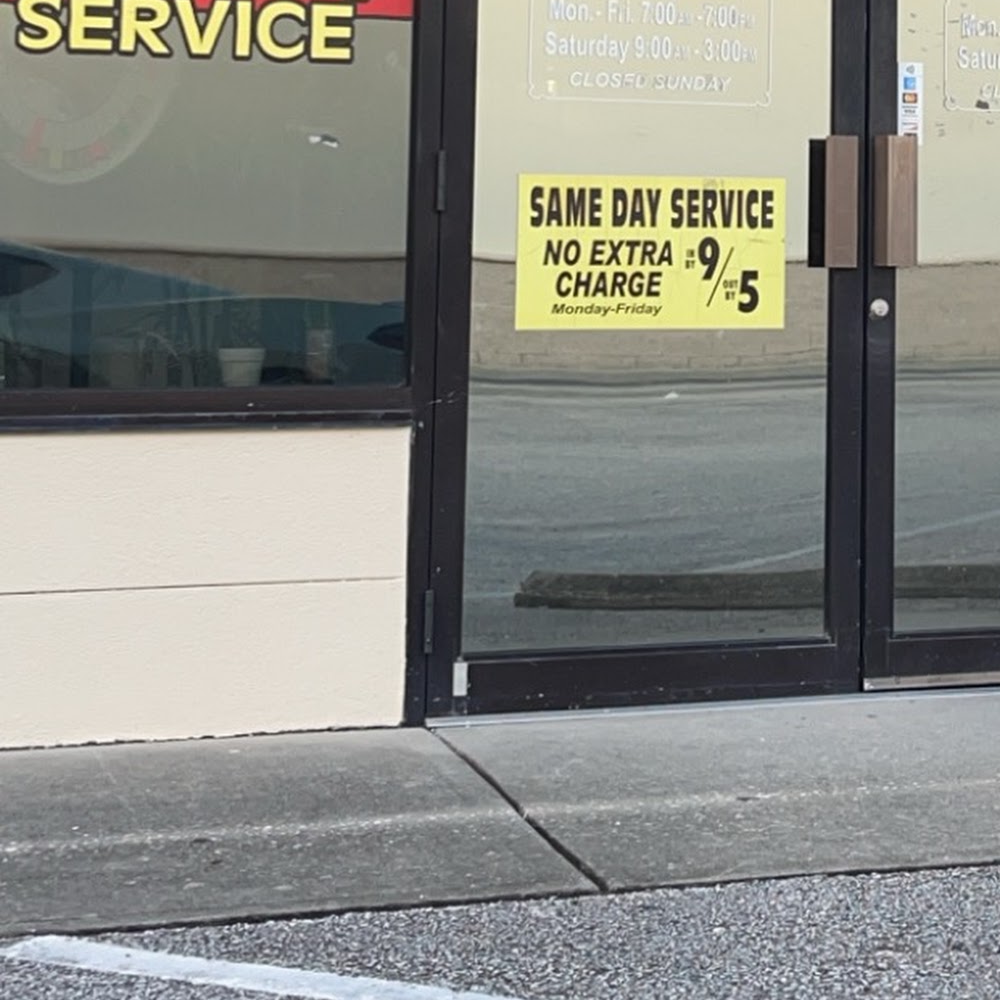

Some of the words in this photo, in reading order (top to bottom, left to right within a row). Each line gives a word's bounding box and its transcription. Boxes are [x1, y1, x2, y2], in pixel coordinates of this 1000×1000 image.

[544, 30, 629, 63] Saturday
[569, 71, 647, 89] CLOSED
[653, 74, 732, 92] SUNDAY
[530, 186, 602, 227] SAME
[612, 188, 661, 228] DAY
[671, 188, 774, 229] SERVICE
[543, 240, 581, 266] NO
[589, 240, 673, 266] EXTRA
[698, 236, 720, 281] 9
[555, 271, 662, 298] CHARGE
[738, 270, 760, 313] 5
[551, 303, 662, 317] Monday-Friday
